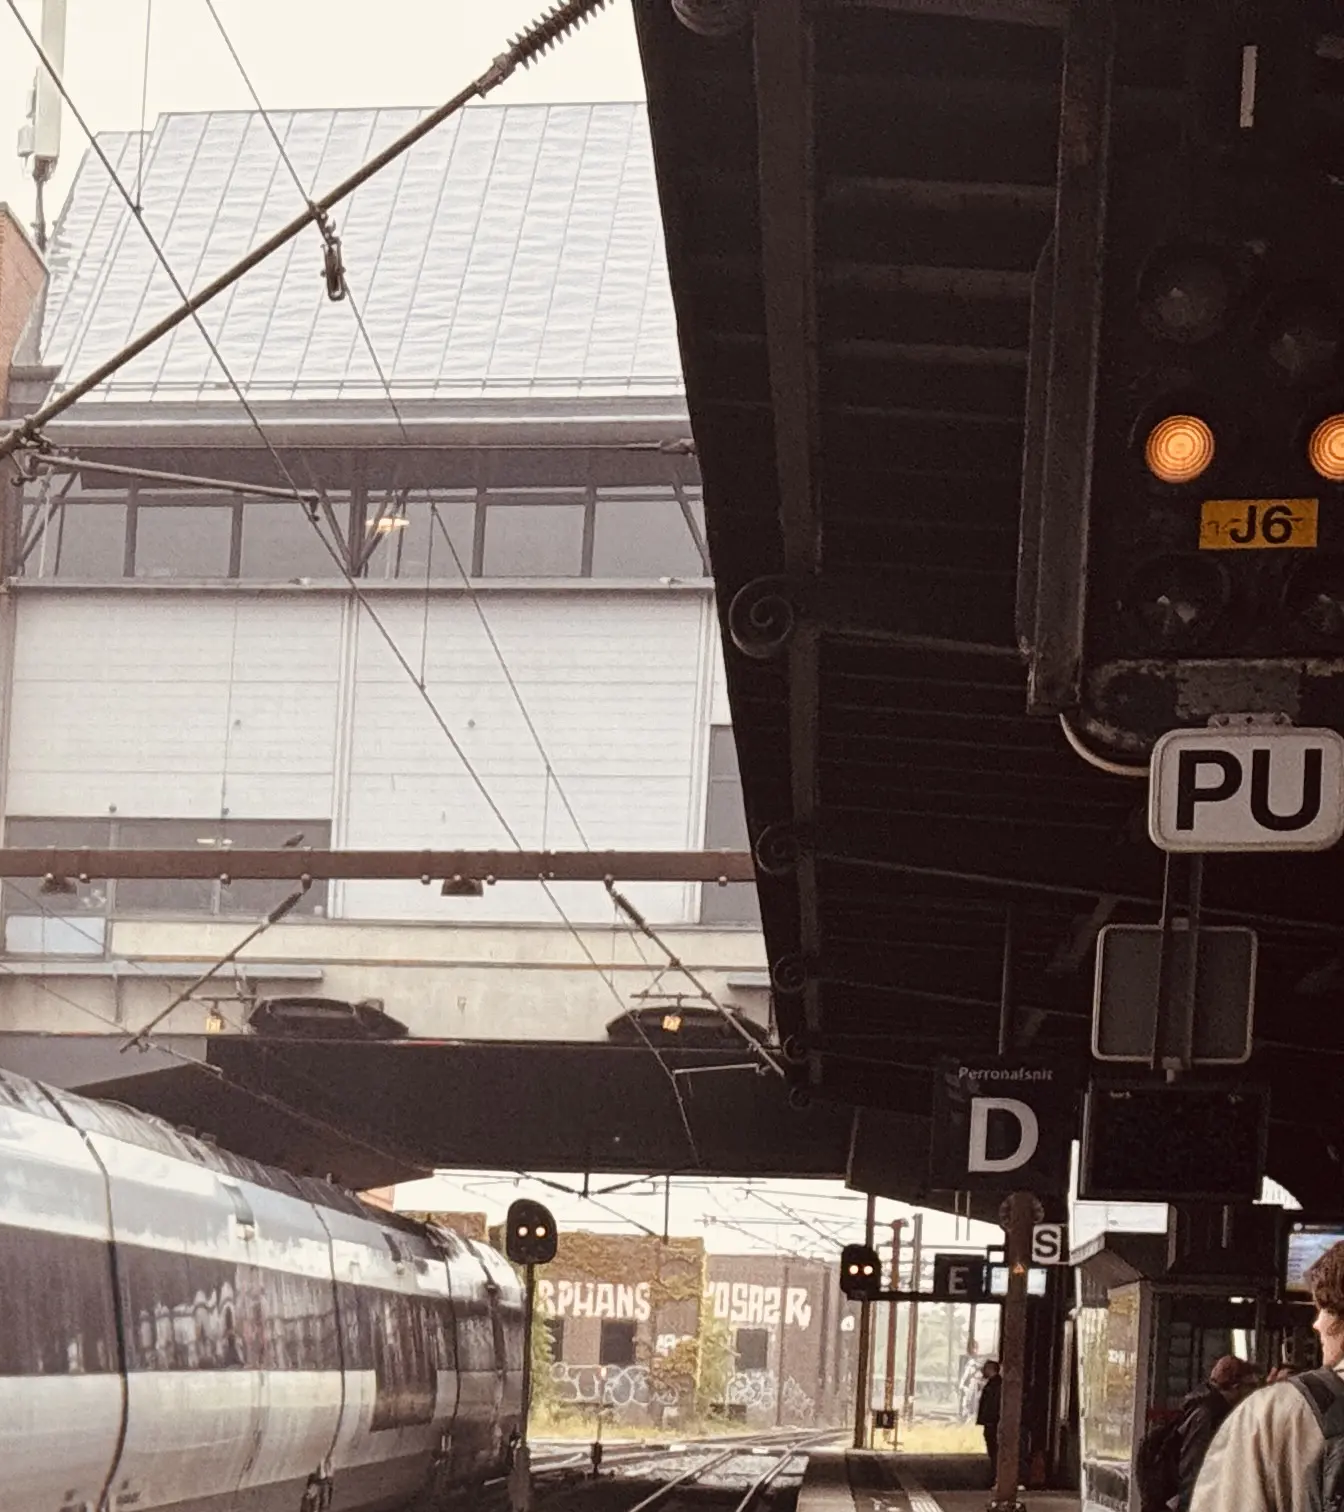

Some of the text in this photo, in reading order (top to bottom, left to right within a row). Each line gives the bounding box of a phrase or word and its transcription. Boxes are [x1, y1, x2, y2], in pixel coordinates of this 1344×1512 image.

[1229, 504, 1293, 544] J6
[1176, 748, 1323, 832] PU
[968, 1096, 1039, 1173] D
[1034, 1229, 1059, 1258] S
[948, 1266, 970, 1294] E
